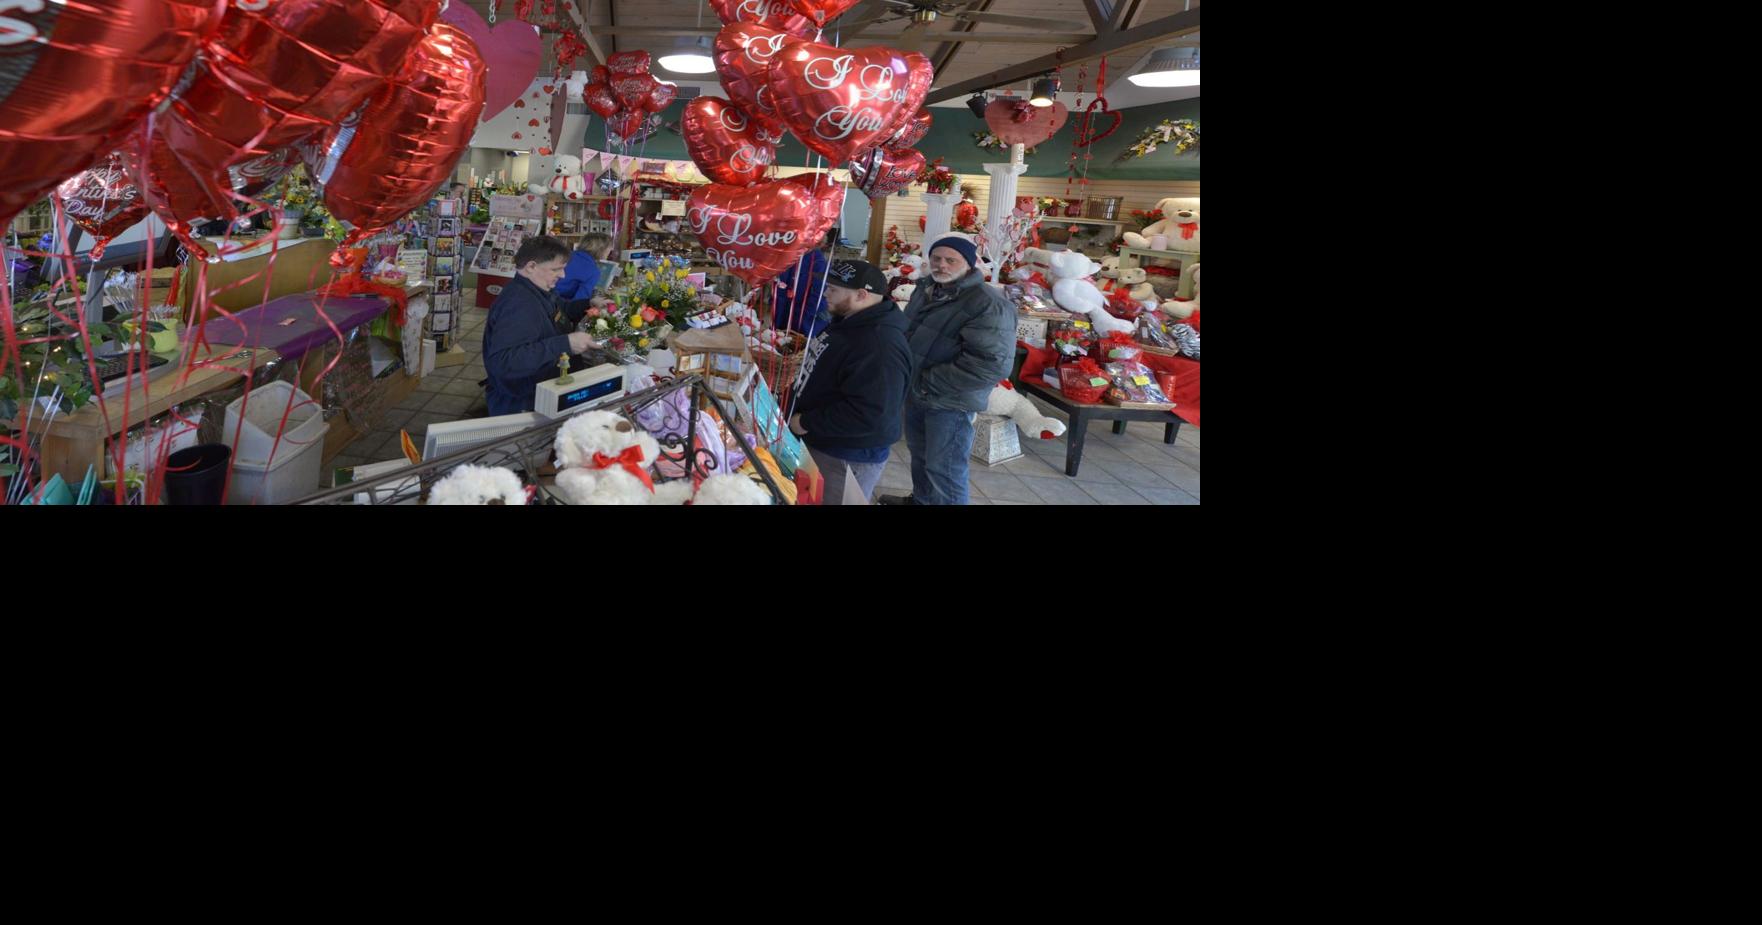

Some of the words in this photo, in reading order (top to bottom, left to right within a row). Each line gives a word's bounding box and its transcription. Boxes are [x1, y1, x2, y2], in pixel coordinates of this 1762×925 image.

[804, 54, 855, 90] I
[814, 105, 882, 140] You
[686, 204, 718, 235] I
[716, 212, 797, 247] Love
[706, 246, 756, 272] You
